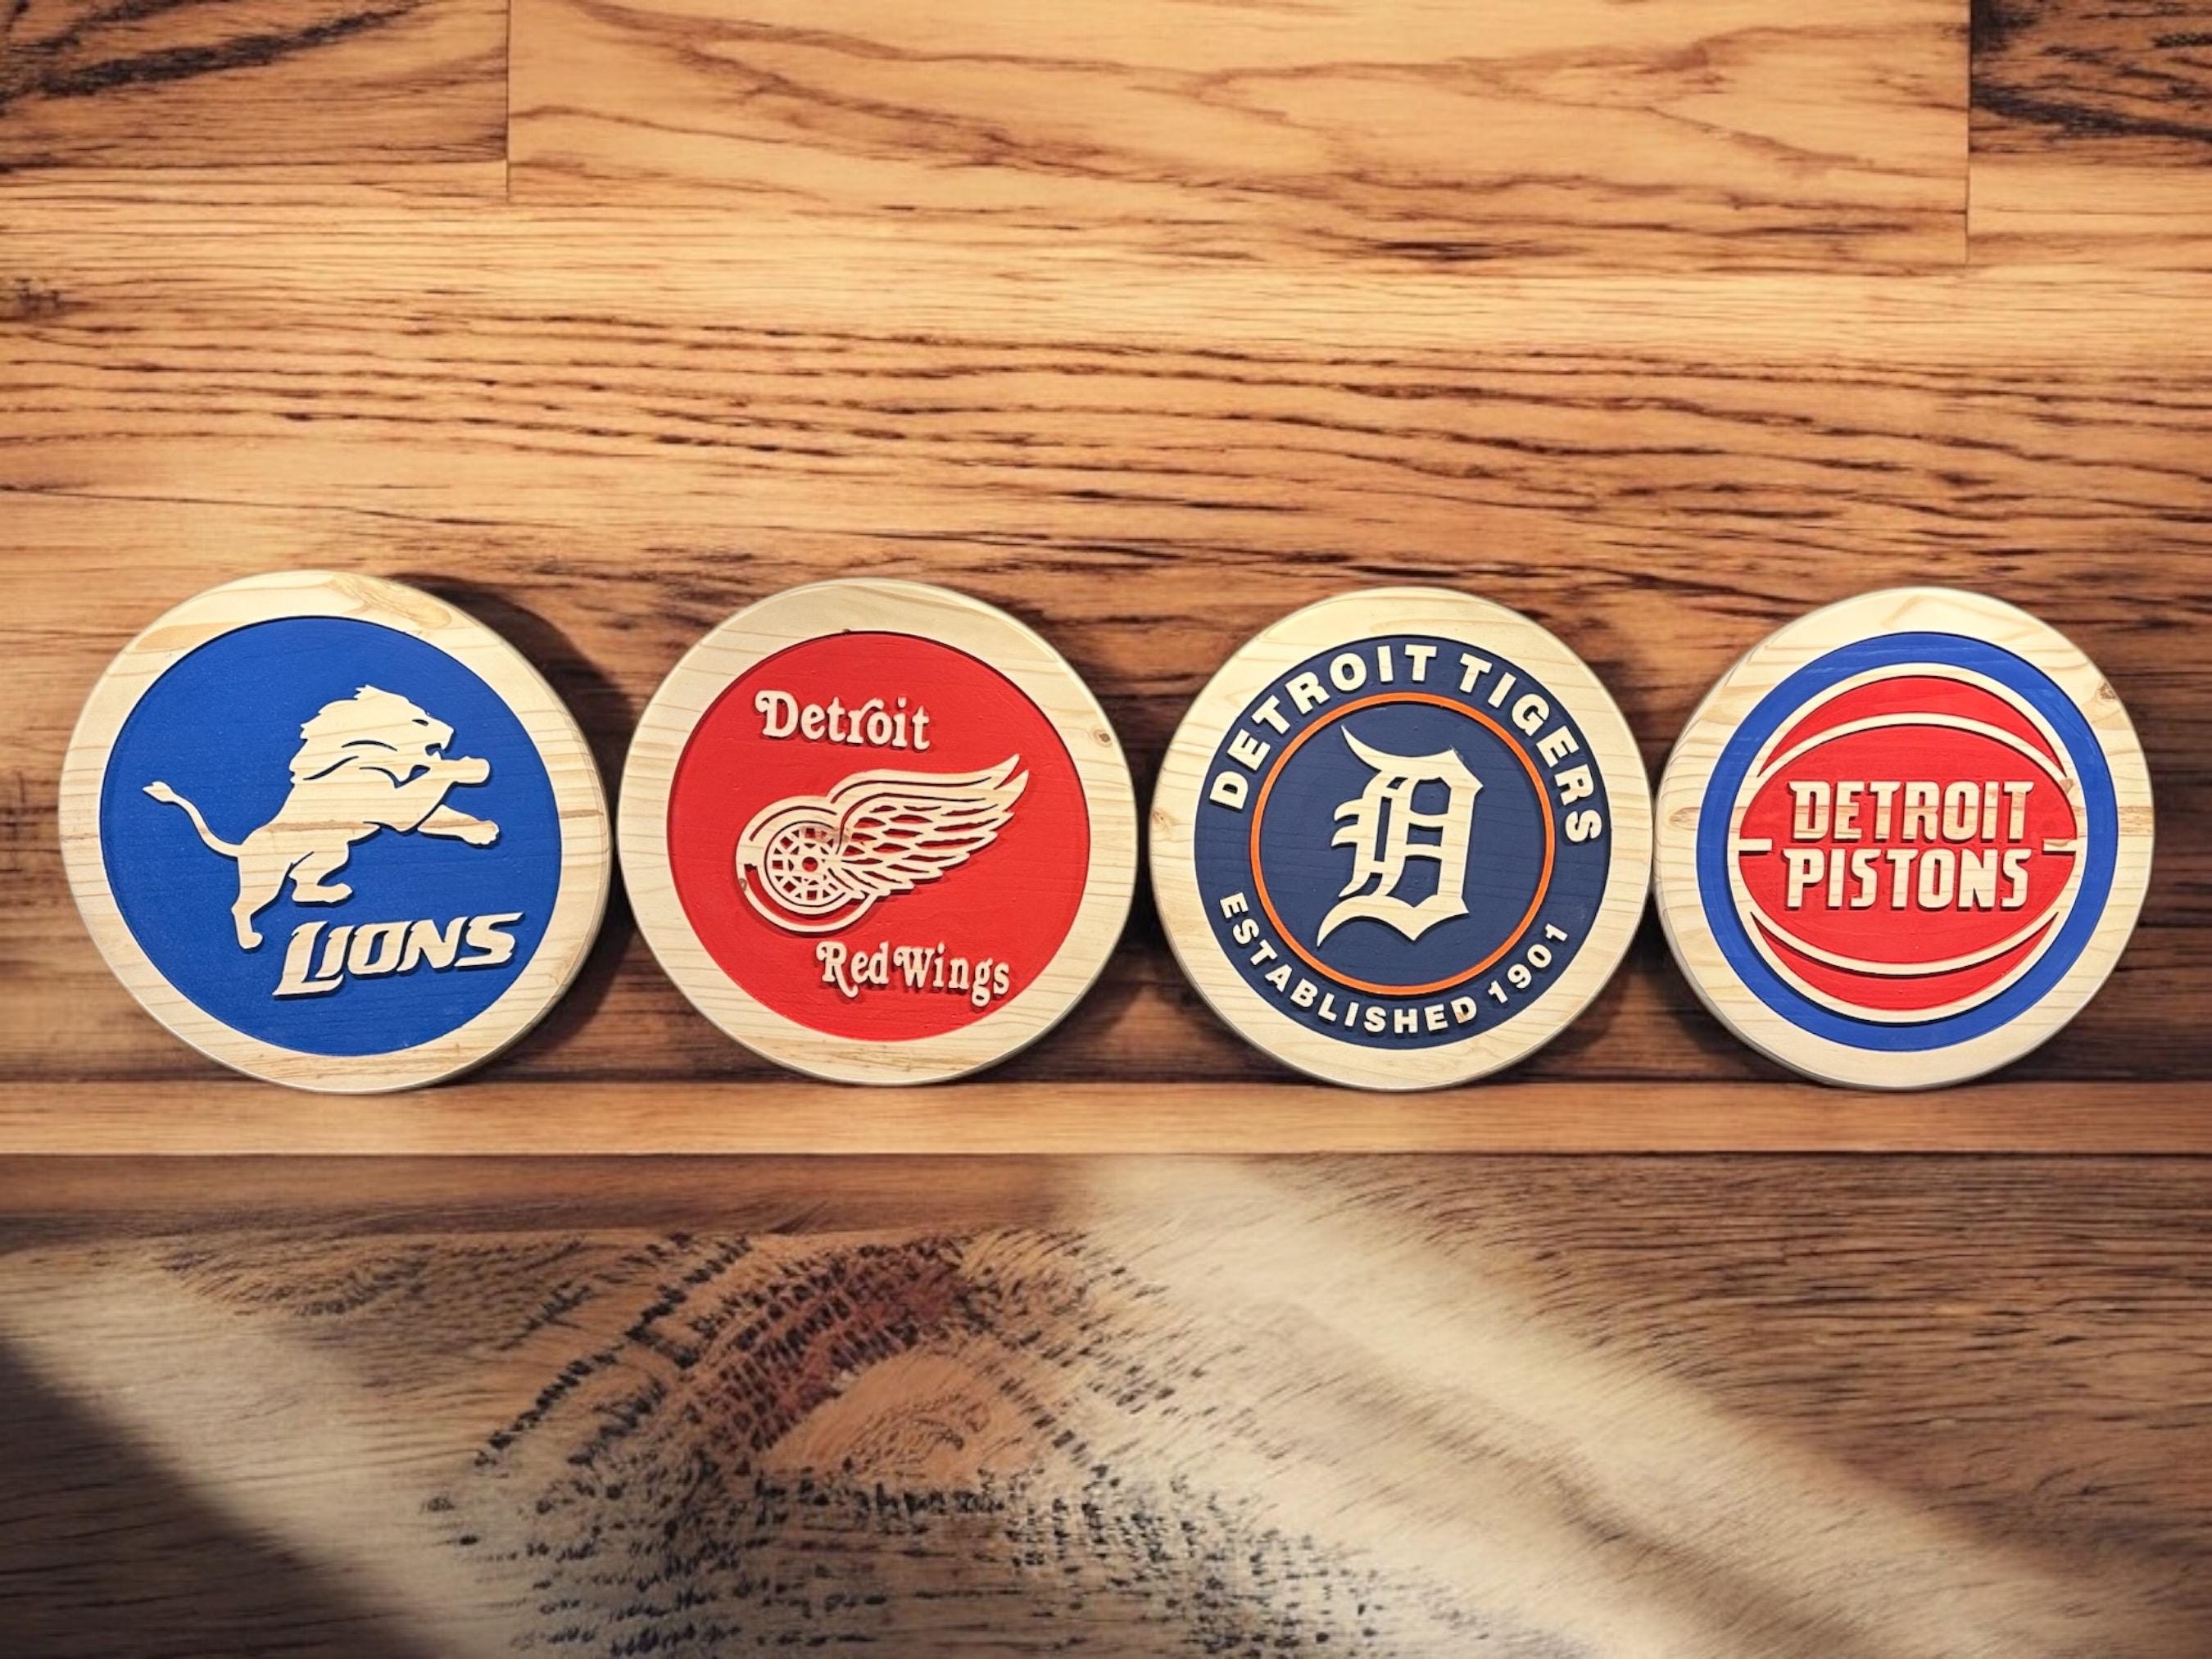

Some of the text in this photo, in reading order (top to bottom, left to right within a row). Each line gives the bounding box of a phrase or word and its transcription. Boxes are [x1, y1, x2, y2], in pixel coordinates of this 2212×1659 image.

[755, 690, 930, 750] Detroit
[1209, 644, 1603, 844] DETROIT TIGERS
[1788, 781, 2034, 842] DETROIT
[1783, 848, 2032, 910] PISTONS
[273, 912, 524, 998] LIONS
[1220, 892, 1568, 1035] ESTABLISHED 1901
